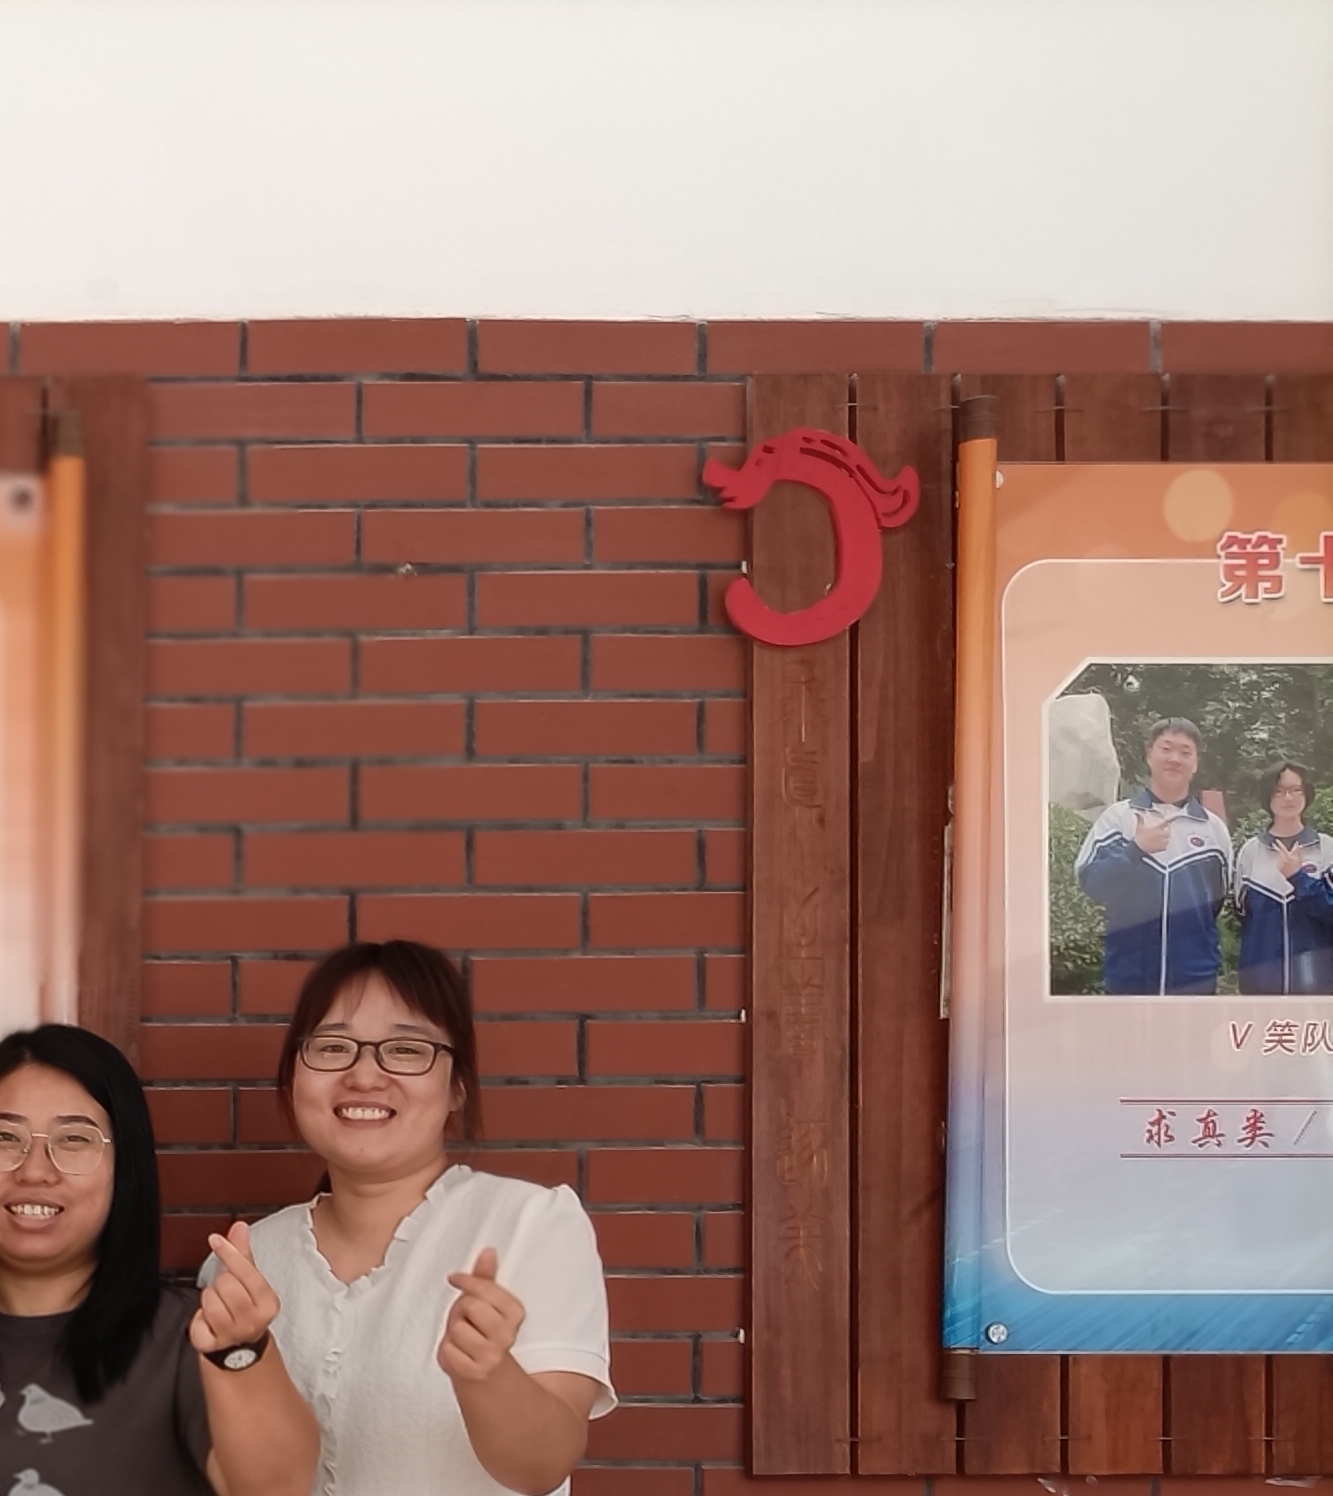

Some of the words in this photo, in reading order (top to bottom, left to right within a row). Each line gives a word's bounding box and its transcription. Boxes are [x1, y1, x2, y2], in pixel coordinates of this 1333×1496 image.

[1230, 1021, 1253, 1050] V
[1144, 1107, 1275, 1149] 求真类
